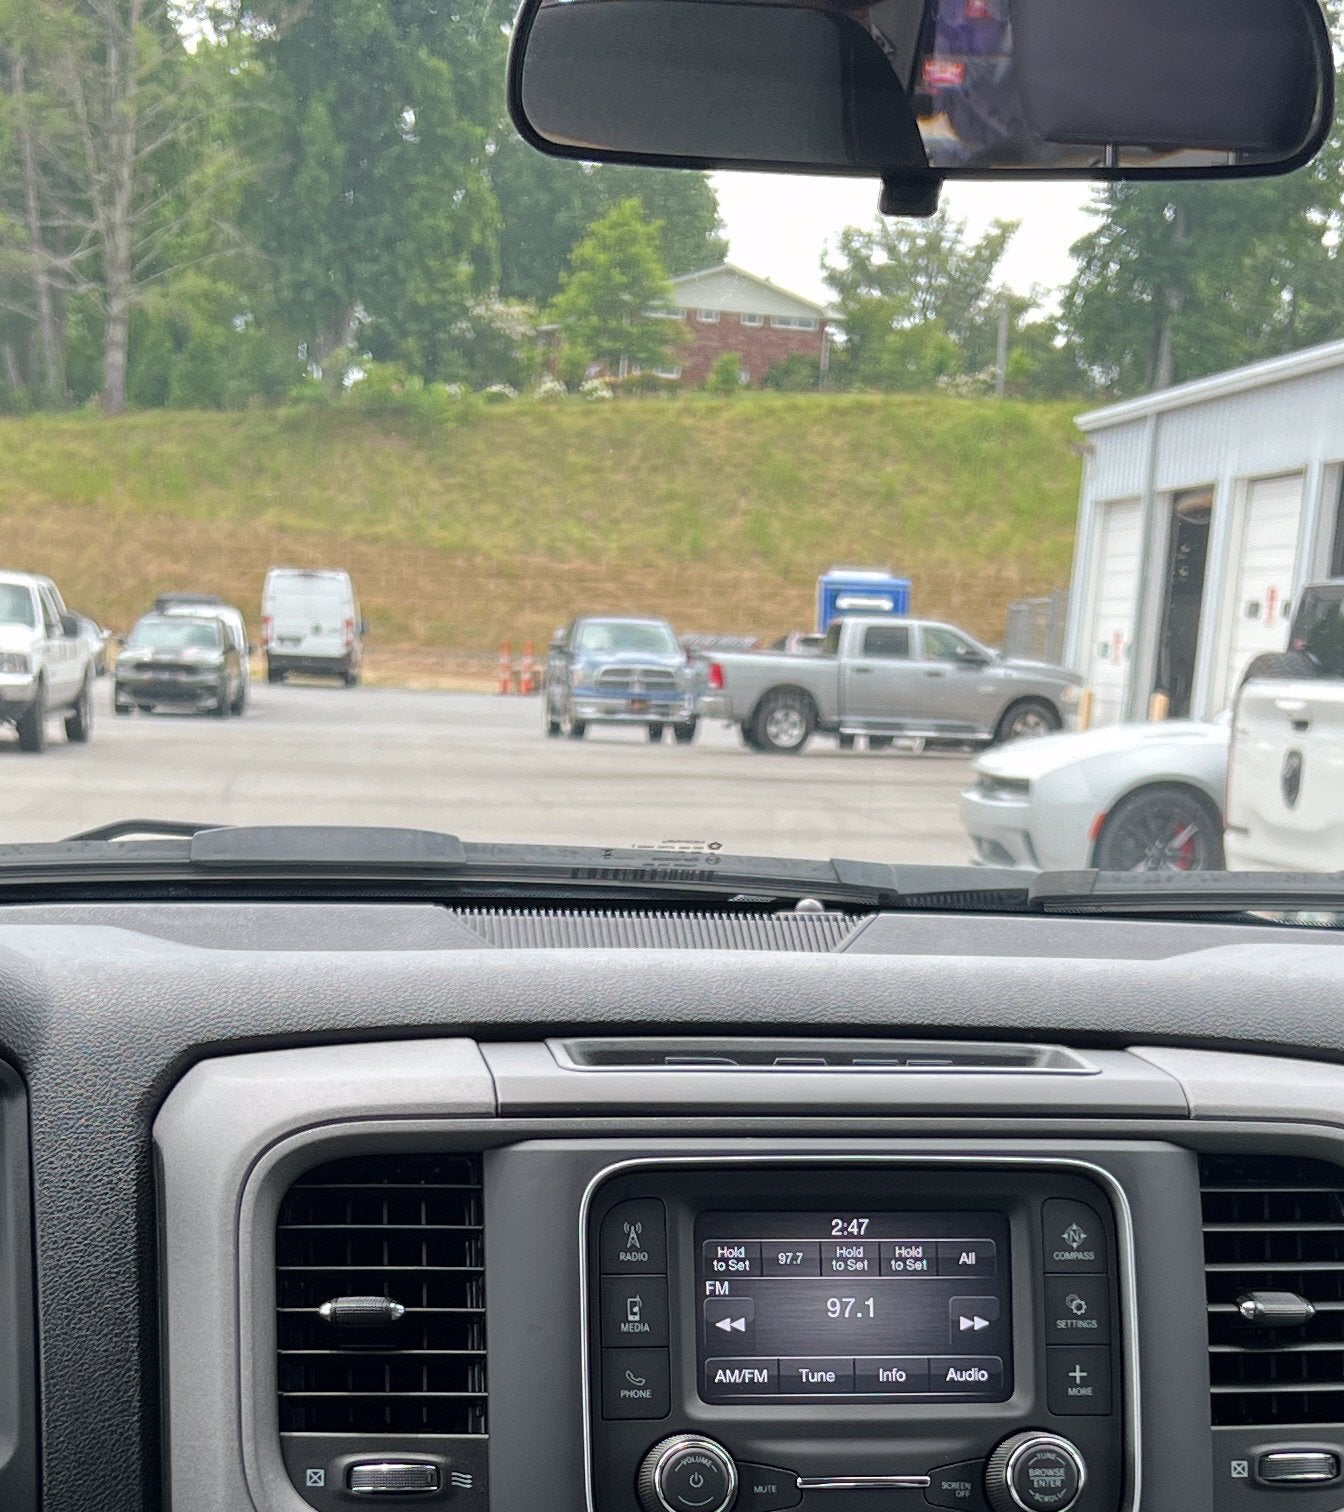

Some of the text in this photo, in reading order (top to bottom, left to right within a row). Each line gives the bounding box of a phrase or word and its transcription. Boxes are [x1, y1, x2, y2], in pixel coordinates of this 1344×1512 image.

[831, 1218, 869, 1236] 2:47
[619, 1252, 649, 1262] RADIO
[717, 1246, 745, 1258] Hold
[836, 1246, 863, 1258] Hold
[895, 1246, 922, 1258] Hold
[959, 1251, 976, 1265] All
[1053, 1251, 1095, 1261] COMPASS
[778, 1252, 804, 1265] 97.7
[712, 1260, 750, 1272] to Set
[832, 1260, 869, 1272] to Set
[891, 1260, 928, 1271] to Set
[705, 1281, 729, 1295] FM
[826, 1297, 875, 1318] 97.1
[620, 1322, 650, 1333] MEDIA
[1056, 1319, 1098, 1329] SETTINGS
[714, 1368, 769, 1385] AM/FM
[799, 1369, 836, 1383] Tune
[879, 1368, 906, 1383] Info
[946, 1367, 988, 1383] Audio
[620, 1389, 652, 1399] PHONE
[1067, 1386, 1094, 1396] MORE
[681, 1456, 713, 1467] VOLUME
[754, 1484, 777, 1494] MUTE
[941, 1481, 972, 1490] SCREEN
[1033, 1479, 1062, 1488] ENTER
[955, 1490, 970, 1498] OFF
